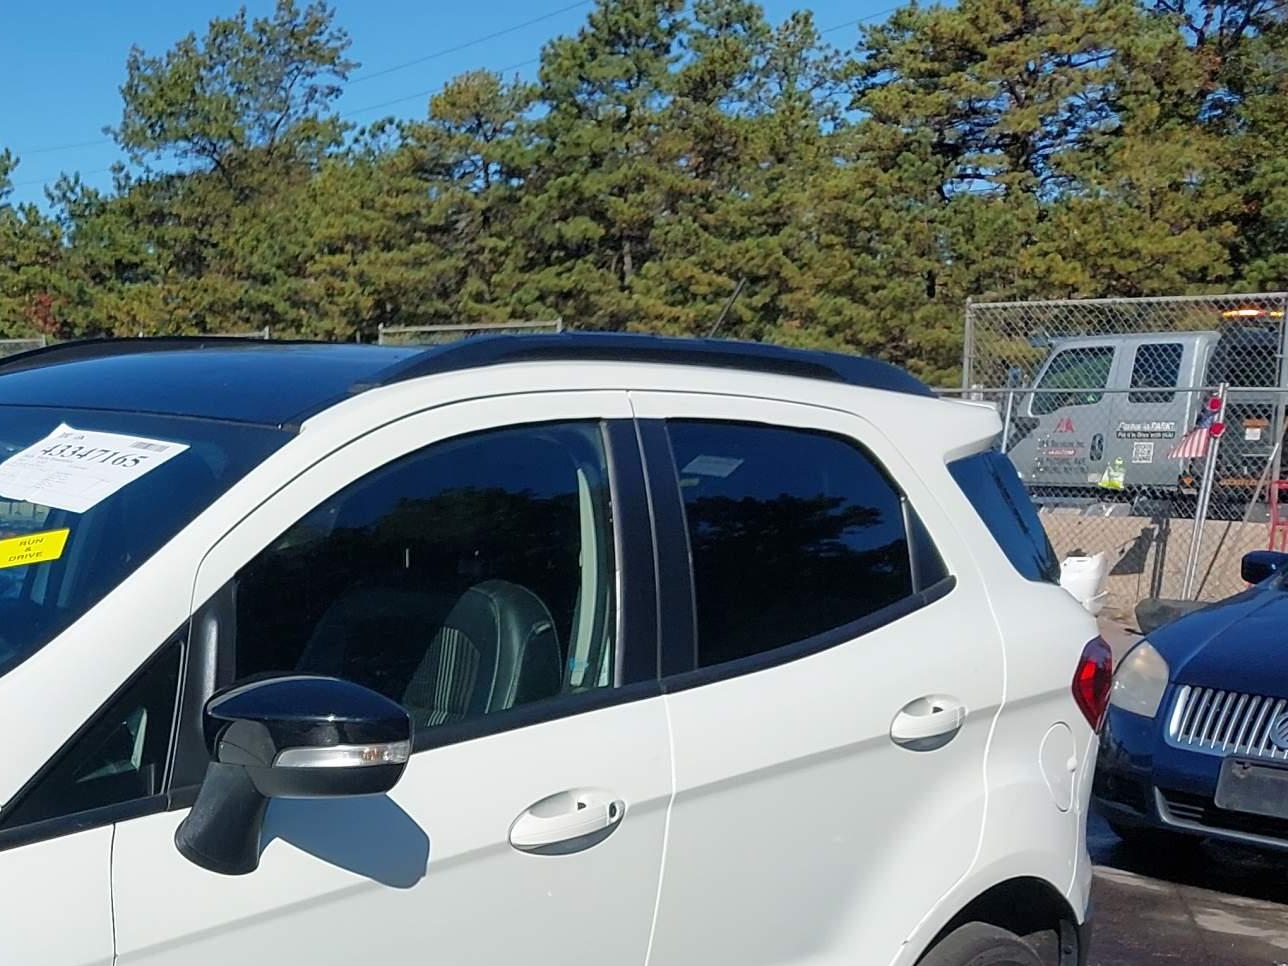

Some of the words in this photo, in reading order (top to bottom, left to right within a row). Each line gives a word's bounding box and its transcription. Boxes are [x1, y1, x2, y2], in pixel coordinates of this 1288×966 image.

[41, 443, 149, 468] 43347165
[19, 538, 44, 547] RUN
[8, 551, 43, 562] DRIVE
